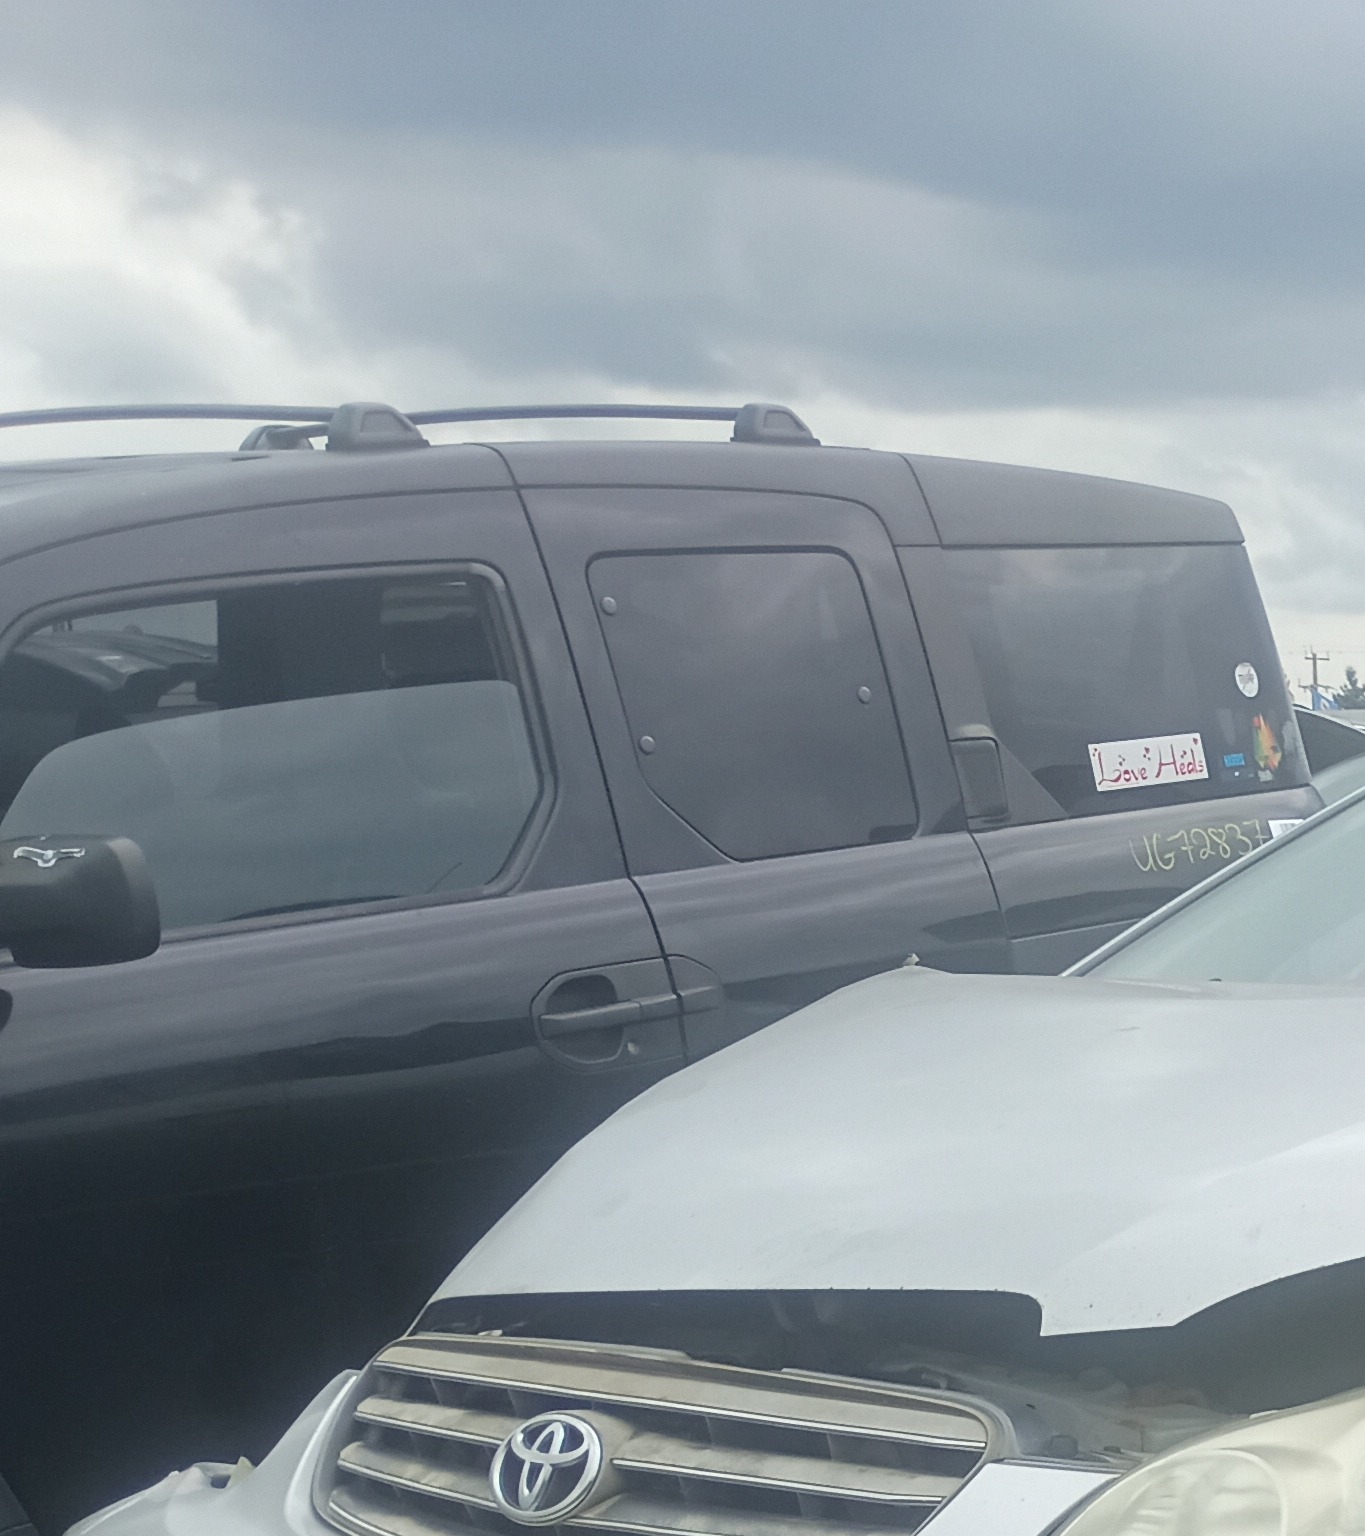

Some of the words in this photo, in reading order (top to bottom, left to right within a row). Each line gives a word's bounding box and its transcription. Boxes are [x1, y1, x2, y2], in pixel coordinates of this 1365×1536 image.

[1098, 750, 1148, 785] Love
[1155, 743, 1204, 779] Heals
[1129, 818, 1270, 872] UG72837
